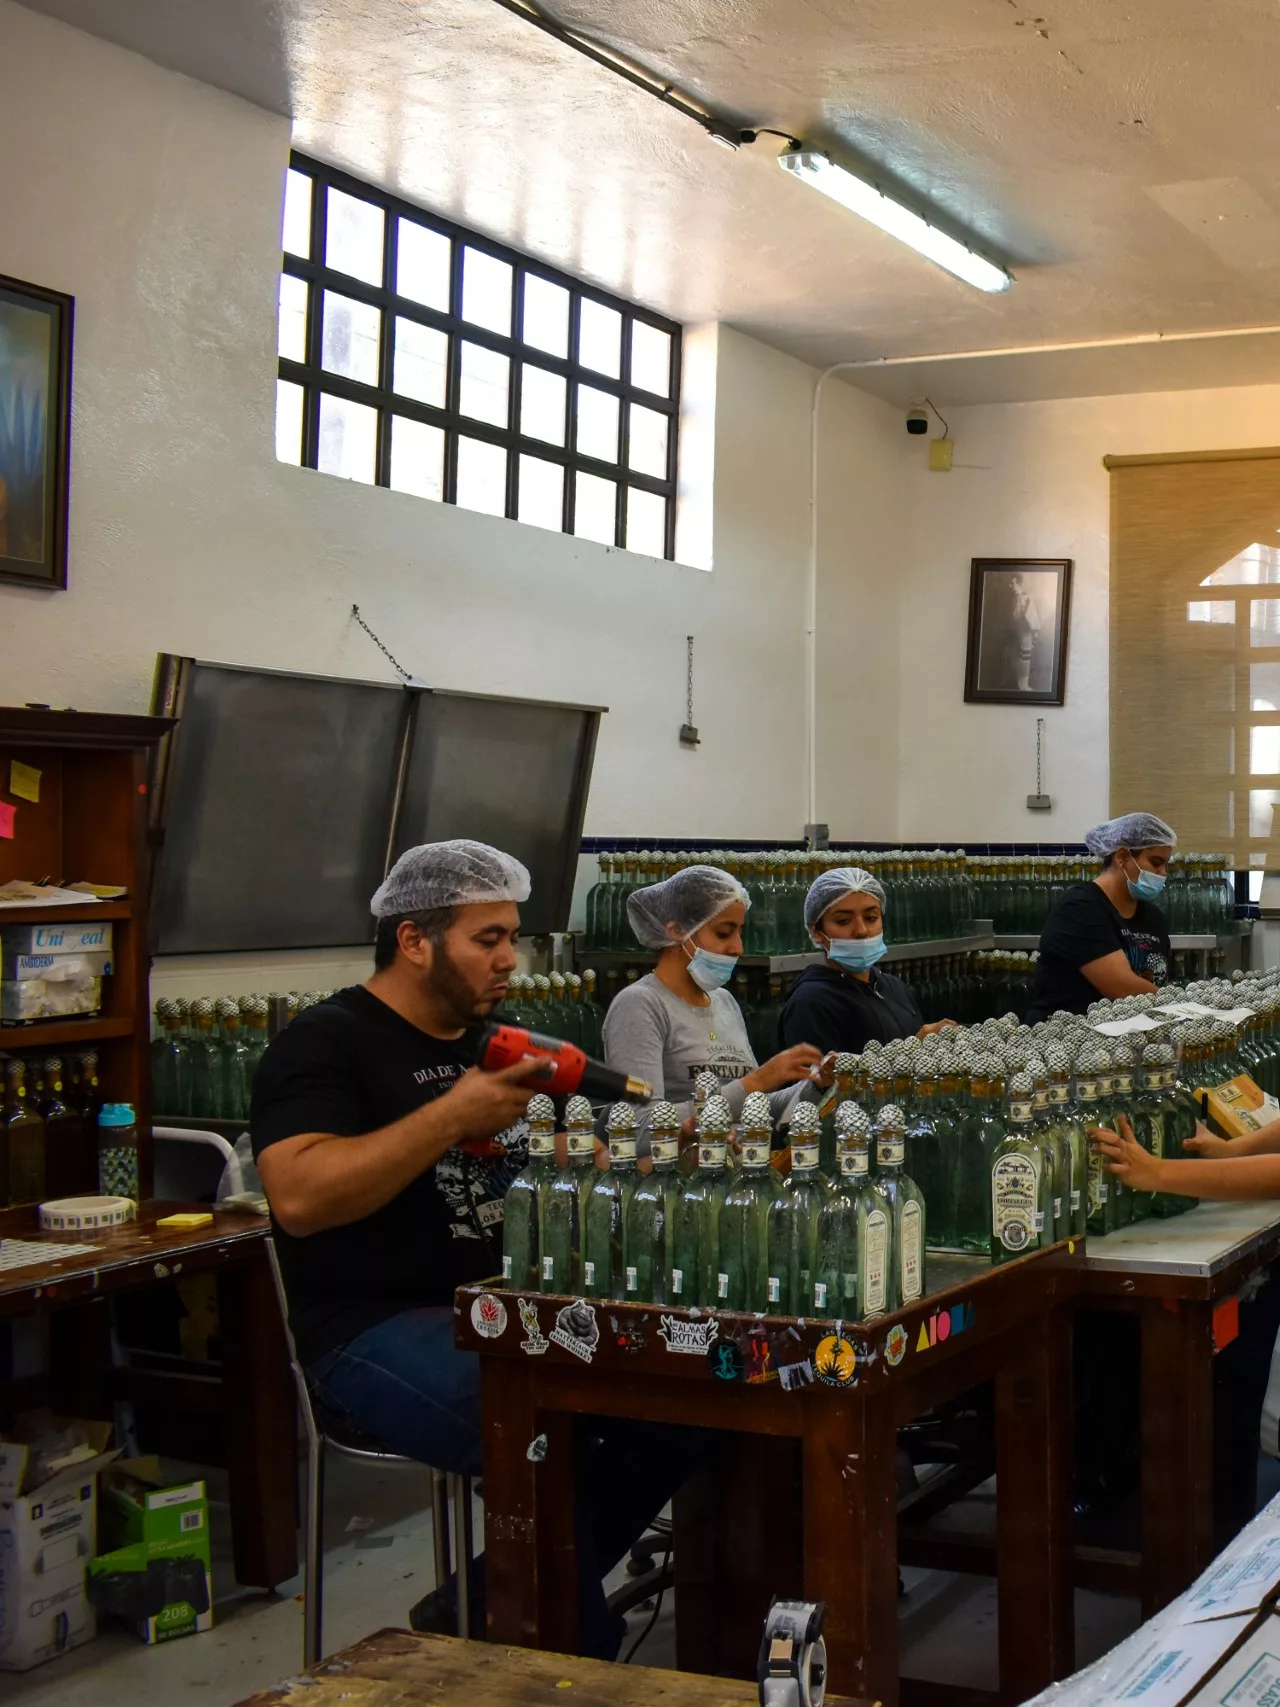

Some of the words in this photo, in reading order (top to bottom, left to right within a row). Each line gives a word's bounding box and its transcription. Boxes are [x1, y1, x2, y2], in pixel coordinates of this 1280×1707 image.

[20, 955, 54, 969] AMBIDERM
[413, 1067, 437, 1084] DIA
[437, 1065, 456, 1077] DE
[687, 1064, 753, 1080] FORTALE
[481, 1213, 496, 1225] OS
[677, 1325, 706, 1335] ALMAS
[820, 1330, 835, 1338] LAS
[550, 1333, 566, 1347] IRISH
[566, 1344, 592, 1361] WHISKEY
[556, 1330, 590, 1355] NATTERJACK
[672, 1333, 706, 1346] ROTAS
[811, 1364, 835, 1386] TEQUILA
[836, 1376, 855, 1388] CLUB
[162, 1605, 188, 1622] 208
